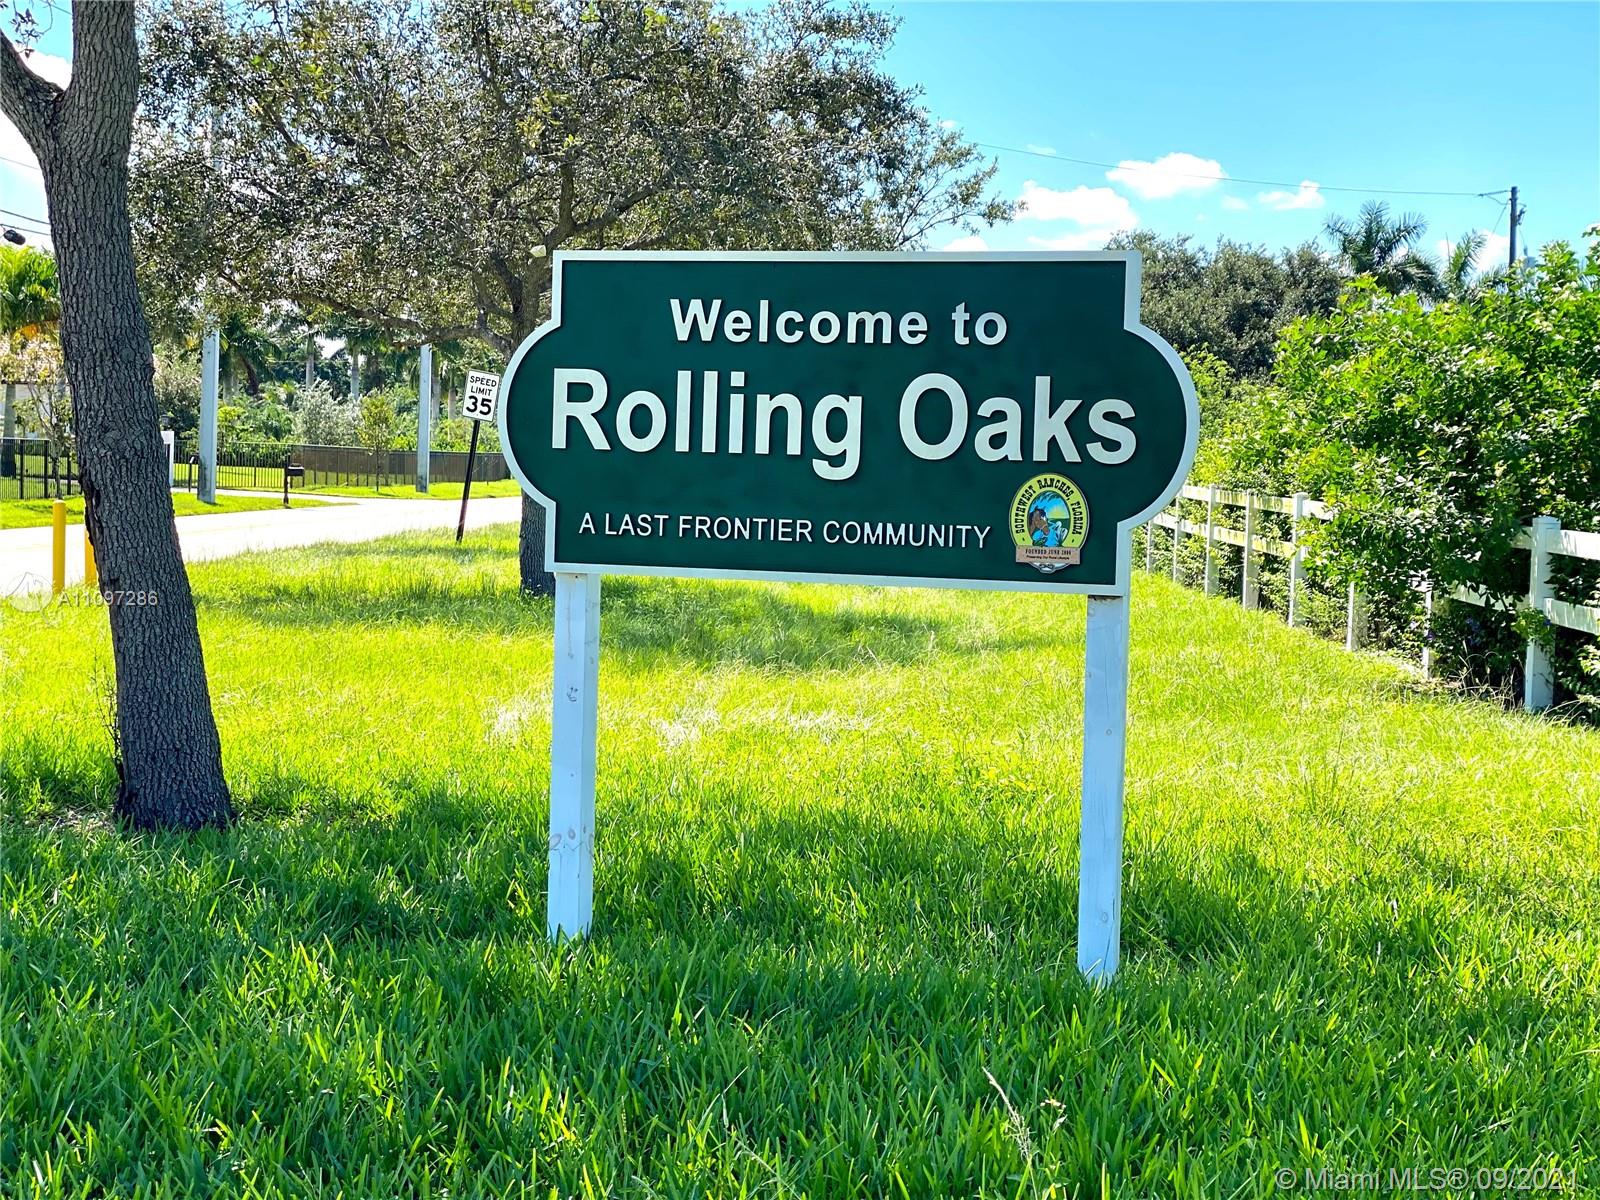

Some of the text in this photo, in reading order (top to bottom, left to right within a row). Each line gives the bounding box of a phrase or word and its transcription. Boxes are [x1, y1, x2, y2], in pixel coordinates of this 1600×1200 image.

[670, 298, 1007, 346] Welcome to
[470, 376, 497, 387] SPEED
[471, 386, 493, 396] LIMIT
[466, 395, 492, 415] 35
[551, 367, 1137, 480] Rolling Oaks
[1015, 485, 1037, 534] SOUTHWEST
[1070, 500, 1084, 535] FLORIDA
[578, 512, 991, 549] A LAST FRONTIER COMMUNITY
